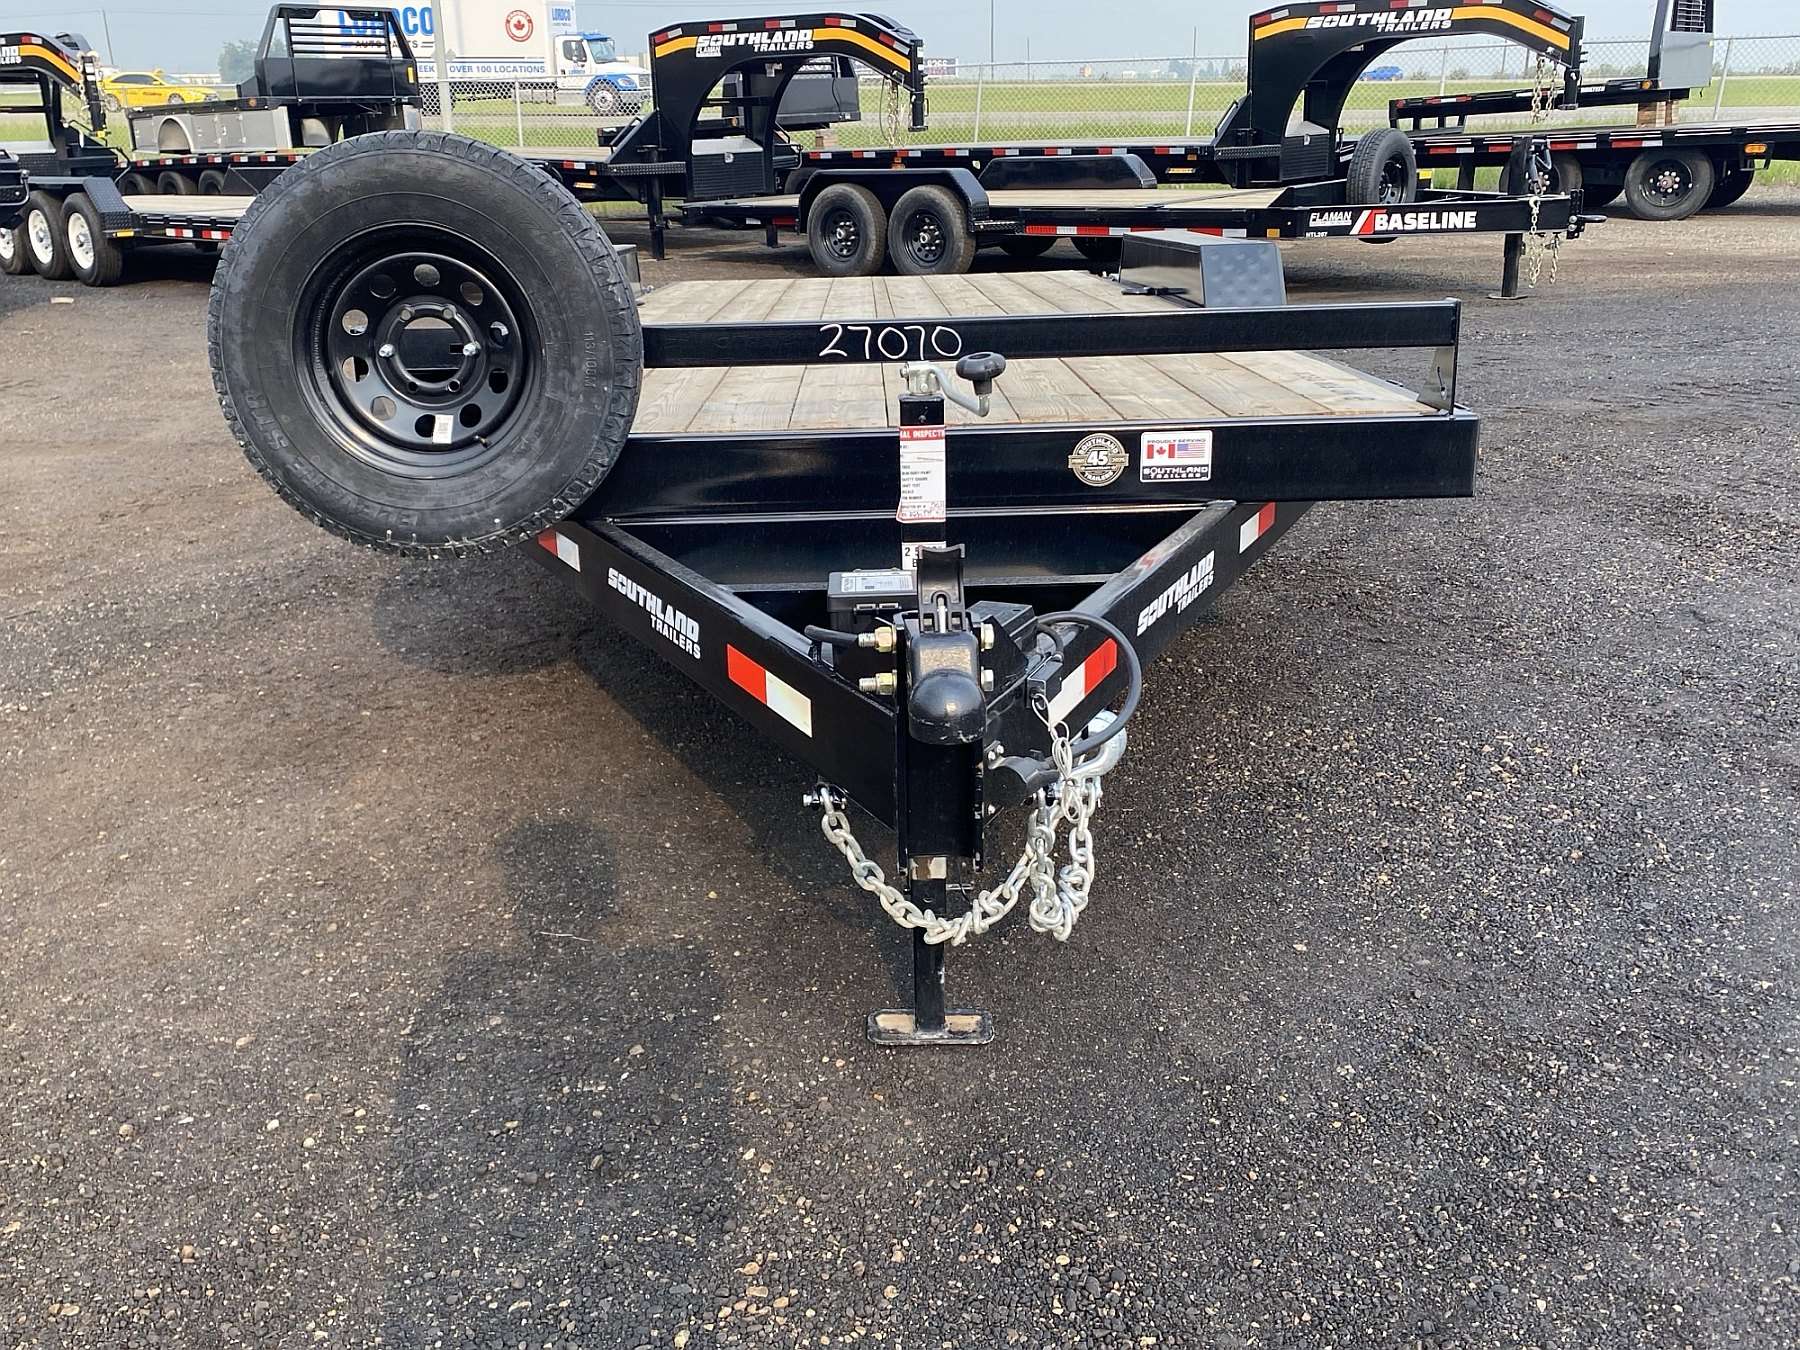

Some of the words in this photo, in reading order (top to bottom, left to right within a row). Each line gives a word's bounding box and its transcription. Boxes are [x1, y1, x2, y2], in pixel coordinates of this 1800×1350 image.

[1306, 8, 1452, 29] SOUTHLAND
[1376, 19, 1452, 33] TRAILERS
[697, 29, 813, 46] SOUTHLAND
[753, 40, 814, 53] TRAILERS
[449, 65, 473, 73] OVER
[476, 65, 492, 73] 100
[494, 65, 545, 73] LOCATIONS
[1311, 211, 1352, 222] FLAMAN
[1375, 211, 1477, 231] BASELINE
[819, 323, 962, 360] 27070
[1087, 450, 1109, 466] 45
[1143, 466, 1208, 475] SOUTHLAND
[1136, 550, 1215, 636] SOUTHLAND
[1177, 570, 1215, 615] TRAILERS
[608, 567, 700, 643] SOUTHLAND
[650, 614, 701, 660] TRAILERS
